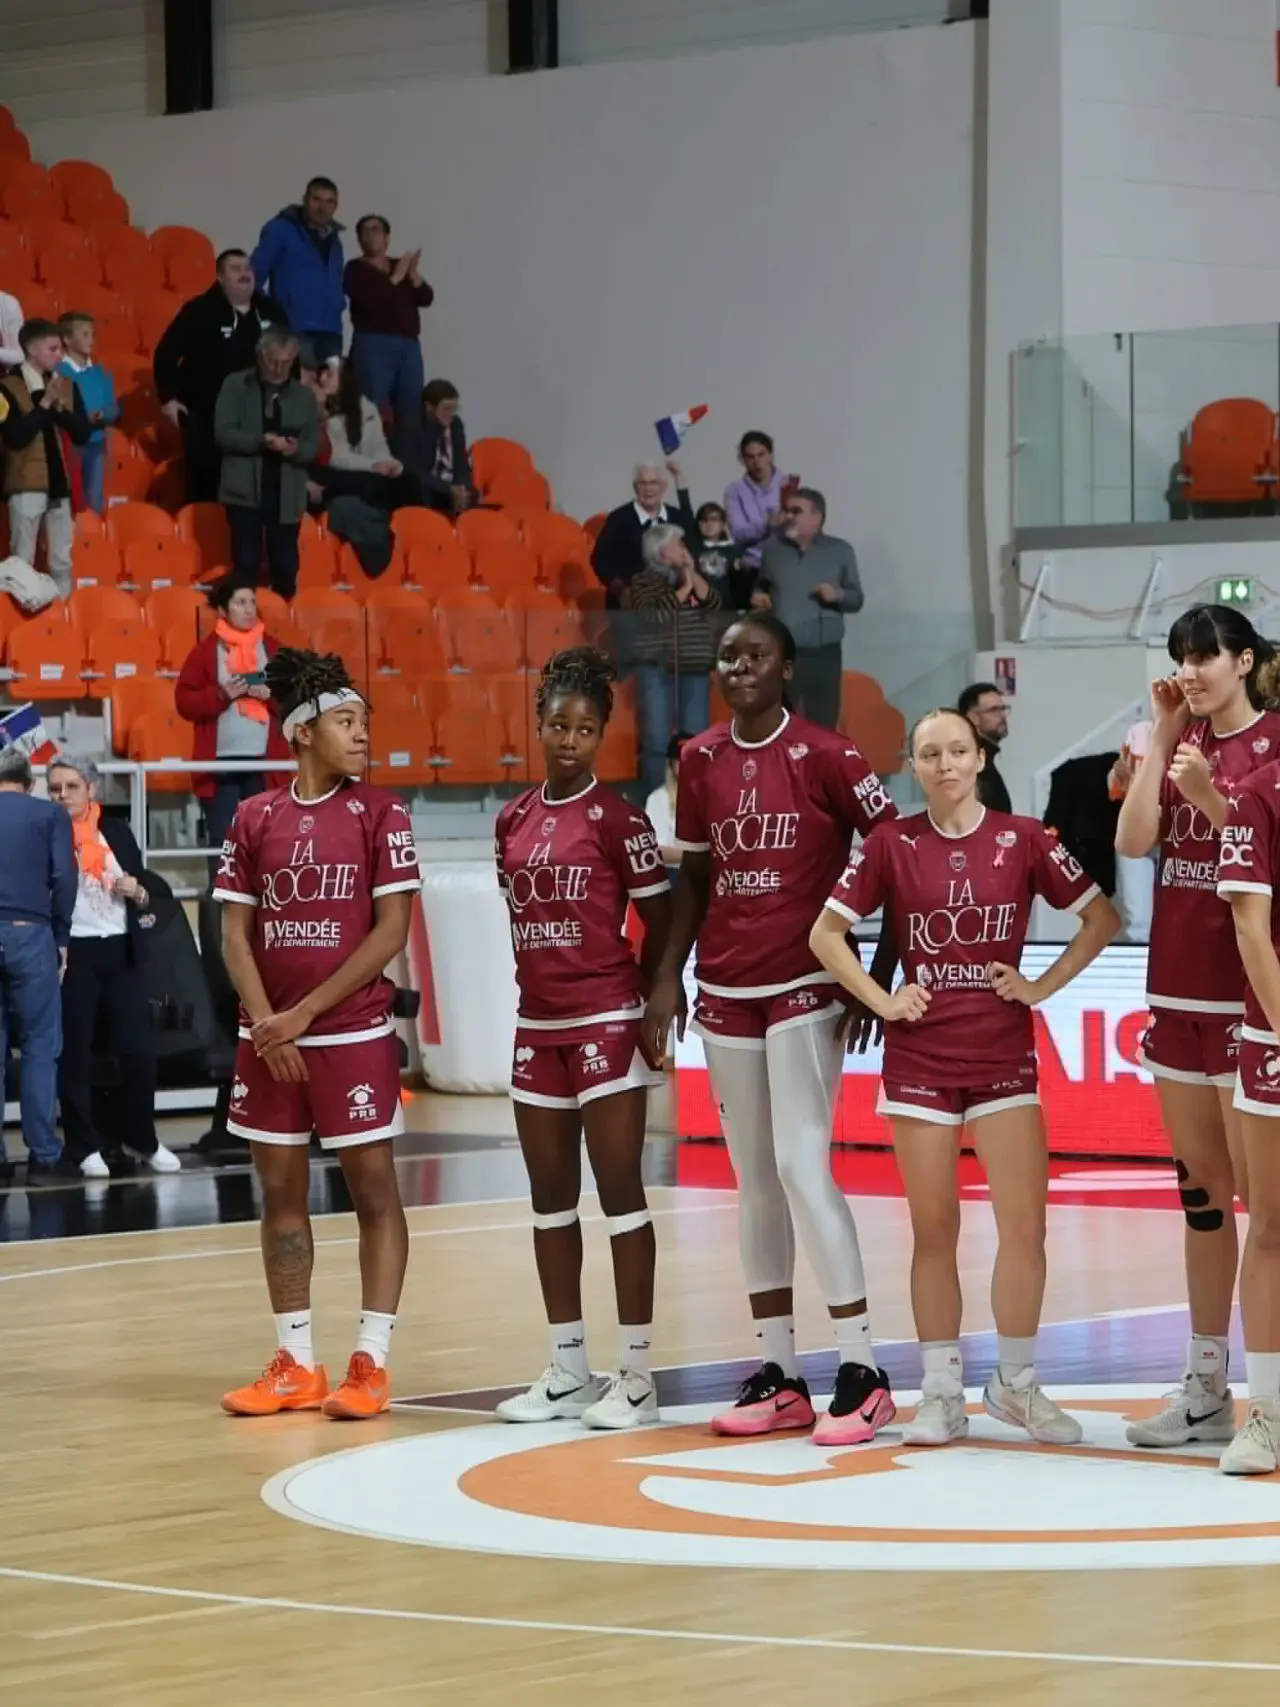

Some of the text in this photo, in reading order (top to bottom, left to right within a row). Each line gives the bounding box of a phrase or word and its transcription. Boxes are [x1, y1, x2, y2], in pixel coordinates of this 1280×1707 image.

[736, 787, 757, 815] LA
[387, 831, 412, 848] NE
[1222, 826, 1254, 843] EW
[289, 839, 315, 866] LA
[389, 846, 417, 869] LO
[527, 840, 551, 867] LA
[1220, 843, 1253, 866] OC
[262, 863, 358, 911] ROCHE
[946, 878, 976, 907] LA
[274, 918, 341, 938] VENDÉE
[519, 917, 583, 939] VENDÉE
[908, 903, 1016, 954] ROCHE
[933, 962, 991, 981] VEND
